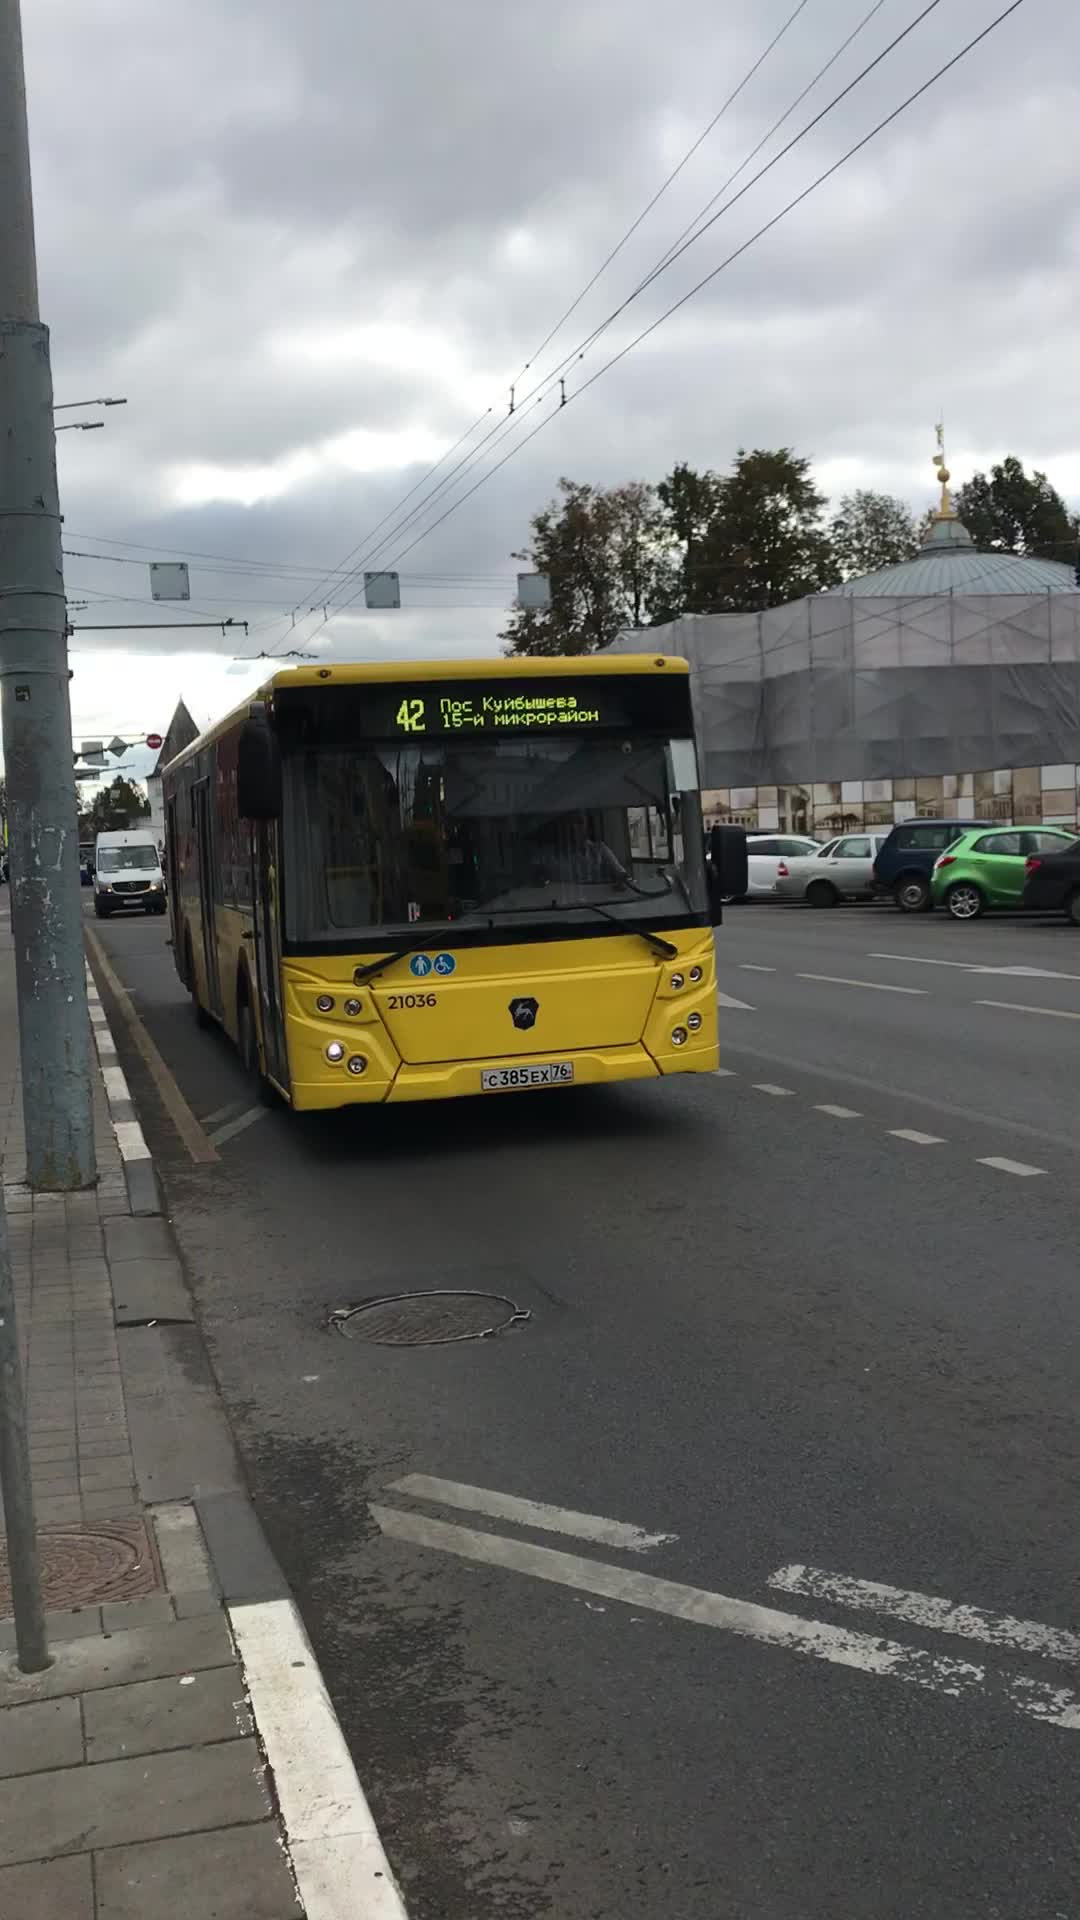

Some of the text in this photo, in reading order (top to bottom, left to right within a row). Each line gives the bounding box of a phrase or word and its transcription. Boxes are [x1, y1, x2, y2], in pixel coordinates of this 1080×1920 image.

[440, 696, 577, 713] Пос Куйбышева
[396, 699, 426, 732] 42
[442, 709, 599, 728] 15-й микрорайон
[387, 993, 437, 1010] 21036
